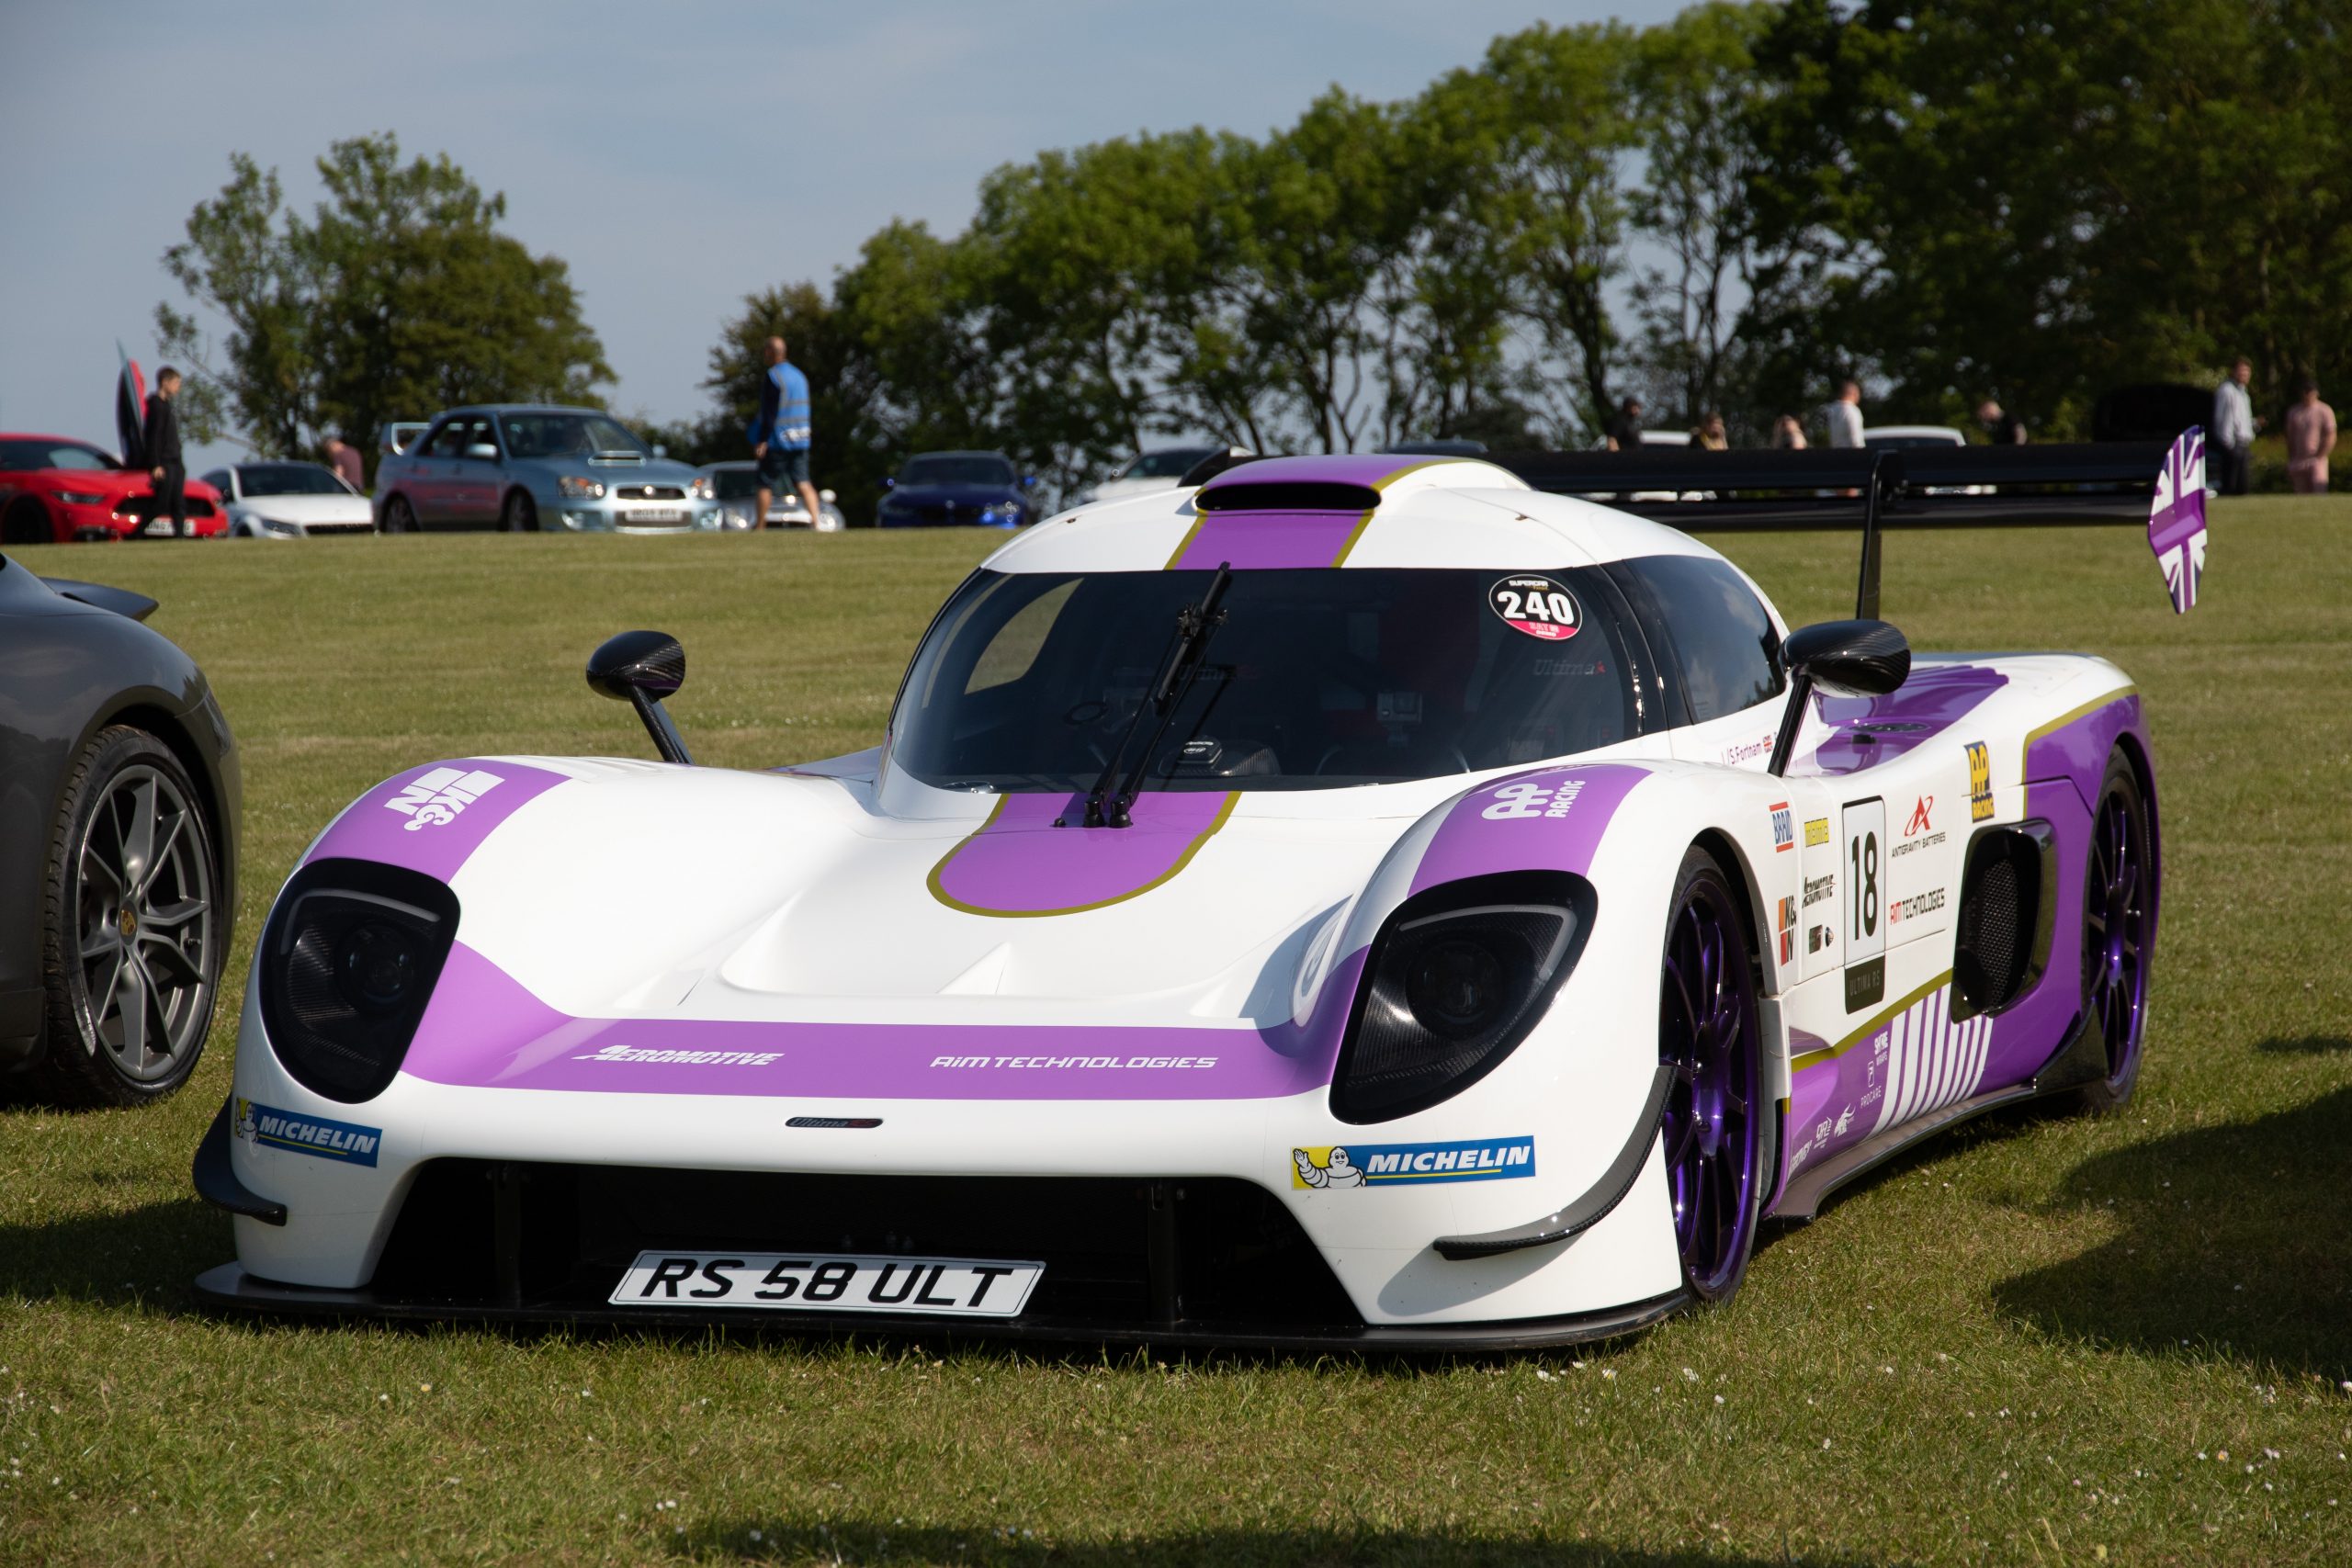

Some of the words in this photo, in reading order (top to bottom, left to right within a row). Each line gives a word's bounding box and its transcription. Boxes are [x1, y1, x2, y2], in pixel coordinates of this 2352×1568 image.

[1497, 591, 1574, 625] 240
[1544, 780, 1586, 818] RACING
[1972, 798, 1995, 820] RACING
[1772, 810, 1793, 844] BRAID
[1892, 840, 1921, 858] ANTIGRAVITY
[1922, 831, 1946, 849] BATTERIES
[1851, 830, 1878, 941] 18
[1902, 887, 1945, 921] TECHNOLOGIES
[571, 1044, 785, 1066] AEROMOTIVE
[1860, 1086, 1882, 1109] PROCARE
[259, 1115, 377, 1154] MICHELIN
[790, 1117, 848, 1127] Ultima
[1366, 1145, 1531, 1173] MICHELIN
[639, 1258, 745, 1299] RS
[753, 1259, 858, 1303] 58
[867, 1263, 1014, 1308] ULT
